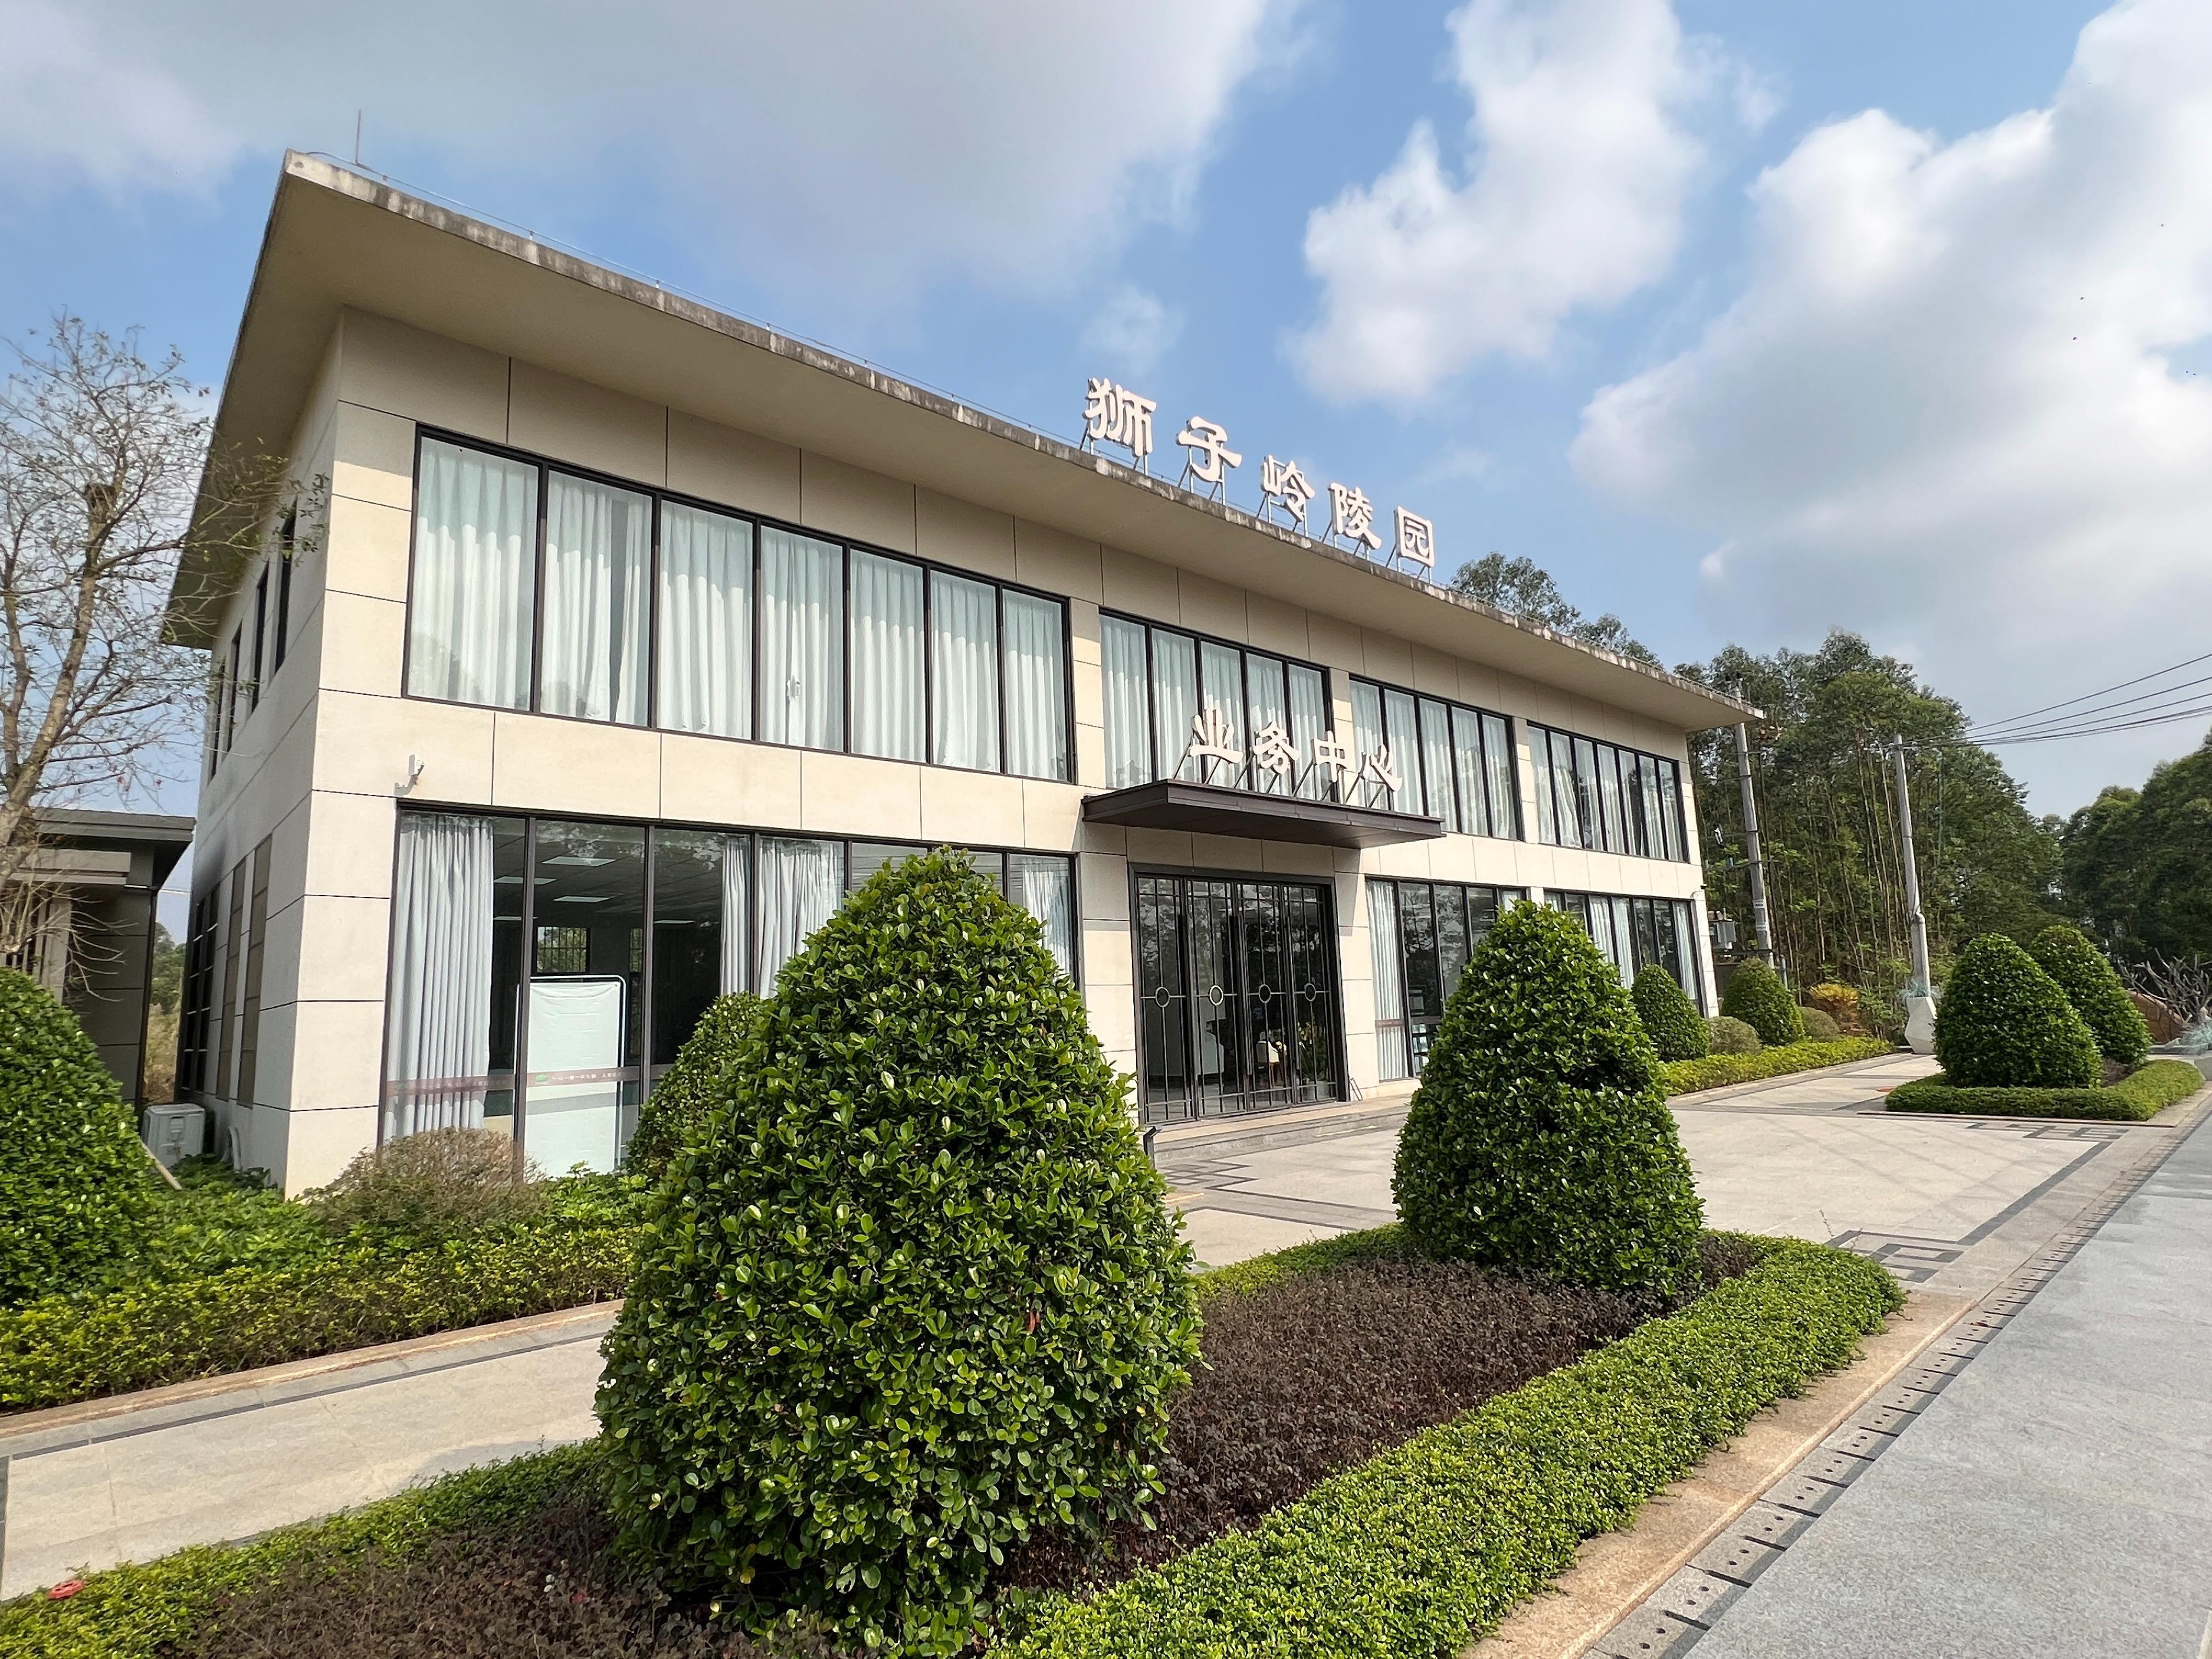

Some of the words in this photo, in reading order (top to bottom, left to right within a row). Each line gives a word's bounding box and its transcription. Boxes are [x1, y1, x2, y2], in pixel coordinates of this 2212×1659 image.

[1082, 377, 1435, 568] 狮子岭陵园
[1187, 707, 1403, 791] 业务中心
